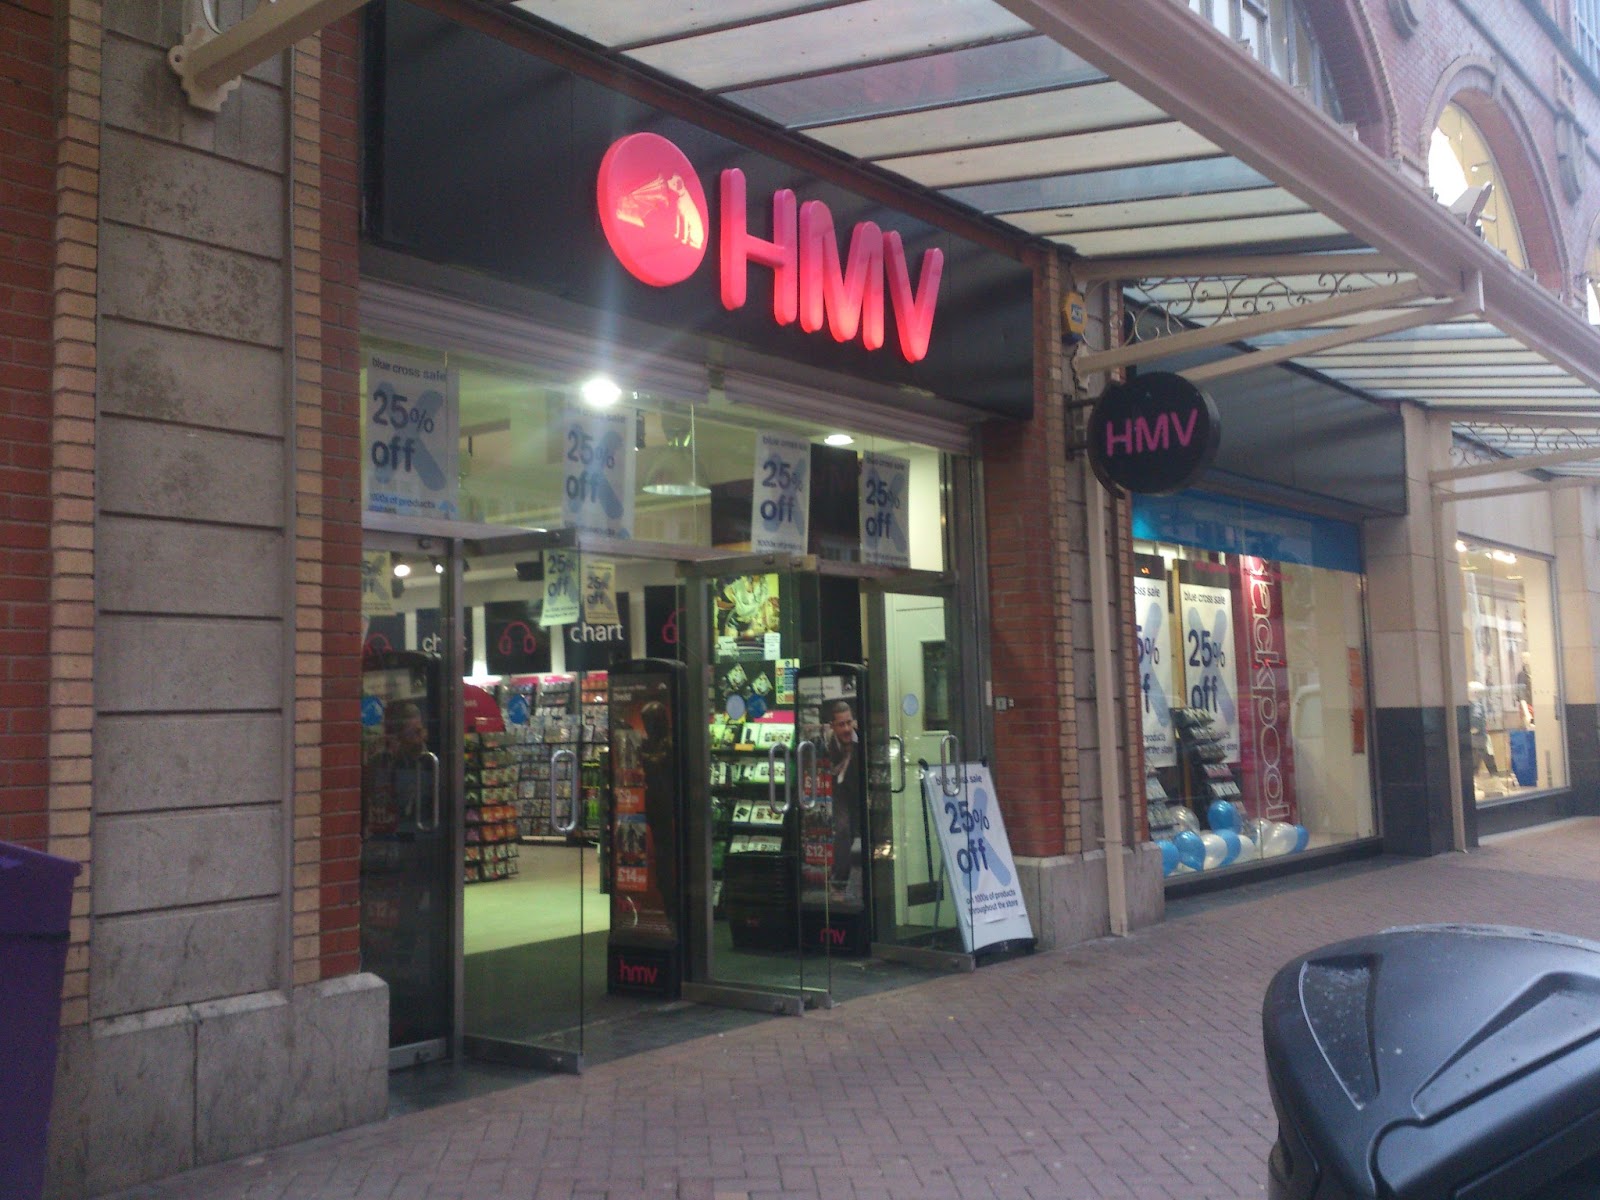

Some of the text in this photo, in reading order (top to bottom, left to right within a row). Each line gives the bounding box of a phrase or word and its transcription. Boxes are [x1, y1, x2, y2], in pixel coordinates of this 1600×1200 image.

[720, 168, 944, 364] HMV
[372, 357, 447, 381] blue cross sale
[372, 390, 434, 433] 25%
[1106, 408, 1198, 457] HMV
[371, 435, 415, 472] off
[566, 470, 598, 503] off
[760, 494, 795, 522] off
[865, 511, 892, 539] off
[1147, 586, 1161, 598] sale
[570, 621, 624, 644] chart
[1136, 625, 1160, 665] 5%
[1188, 629, 1226, 668] 25%
[1191, 675, 1218, 714] off
[969, 774, 983, 783] sale
[945, 801, 990, 834] 25%
[957, 838, 988, 874] off
[989, 891, 995, 900] of
[995, 889, 1016, 900] products
[619, 956, 658, 985] hmv
